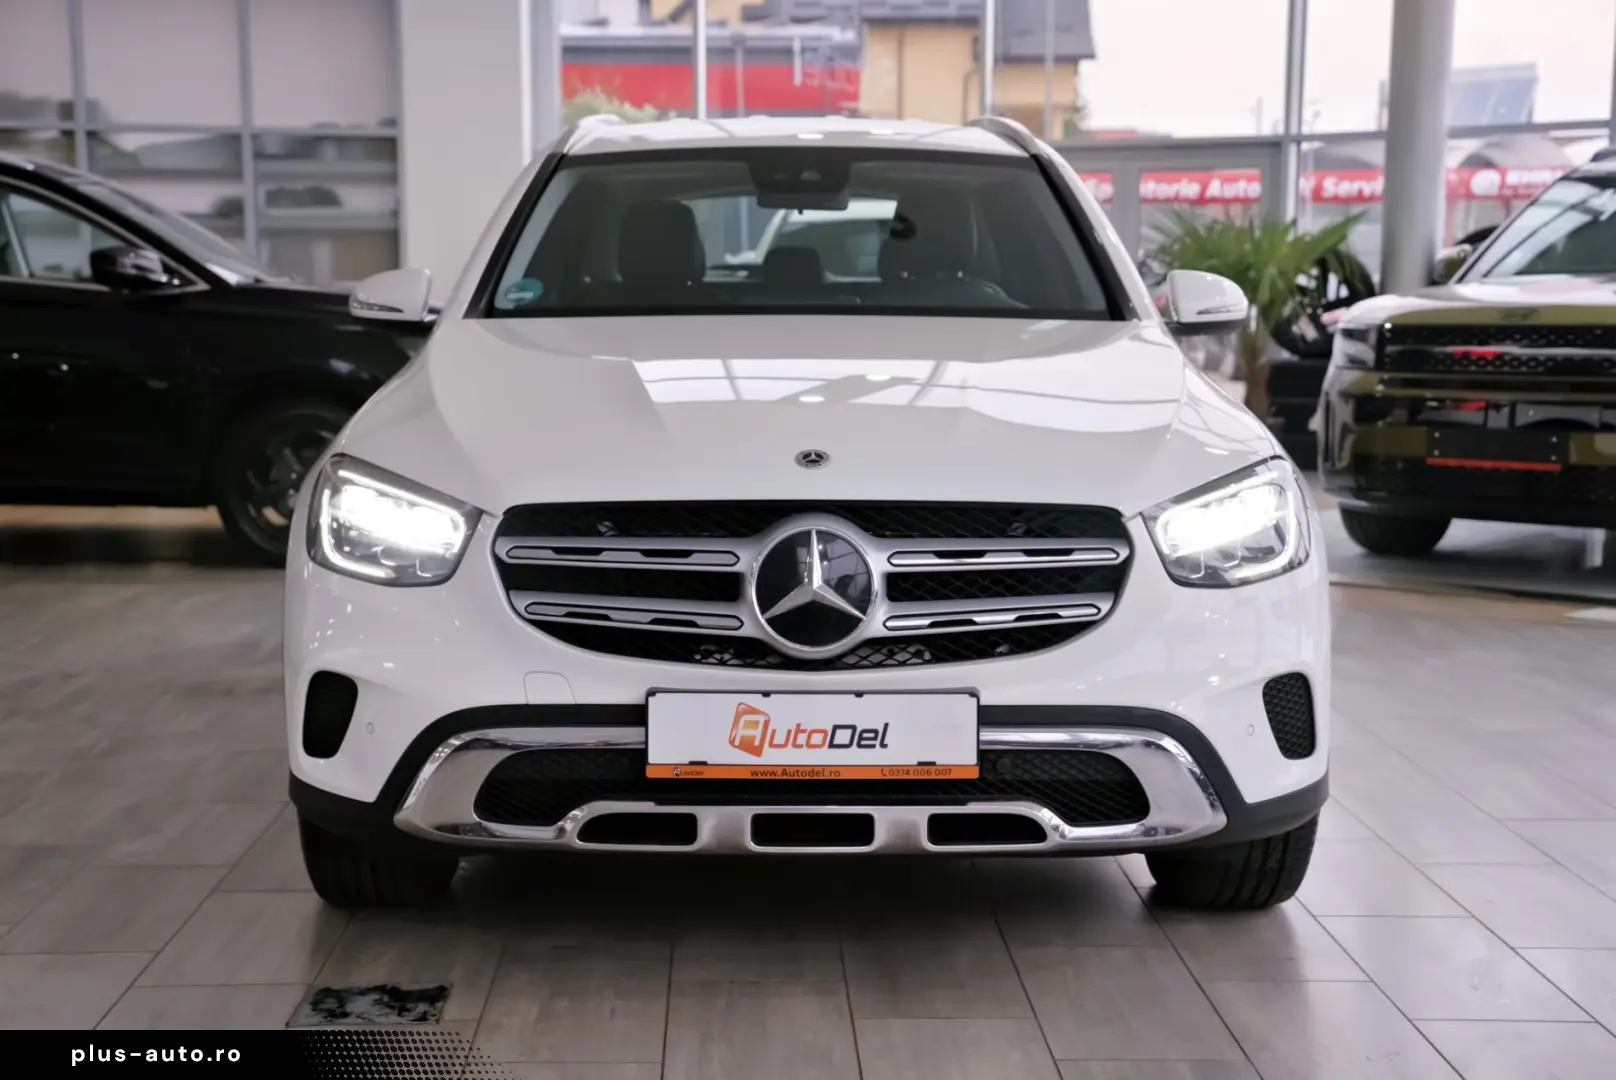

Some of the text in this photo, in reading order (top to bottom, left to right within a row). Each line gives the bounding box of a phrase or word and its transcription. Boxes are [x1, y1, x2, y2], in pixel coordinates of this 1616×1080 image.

[1321, 175, 1385, 199] Servi
[728, 702, 890, 758] AutoDel
[750, 768, 841, 778] www.Autodel.ro
[888, 768, 953, 777] 0374 006 007
